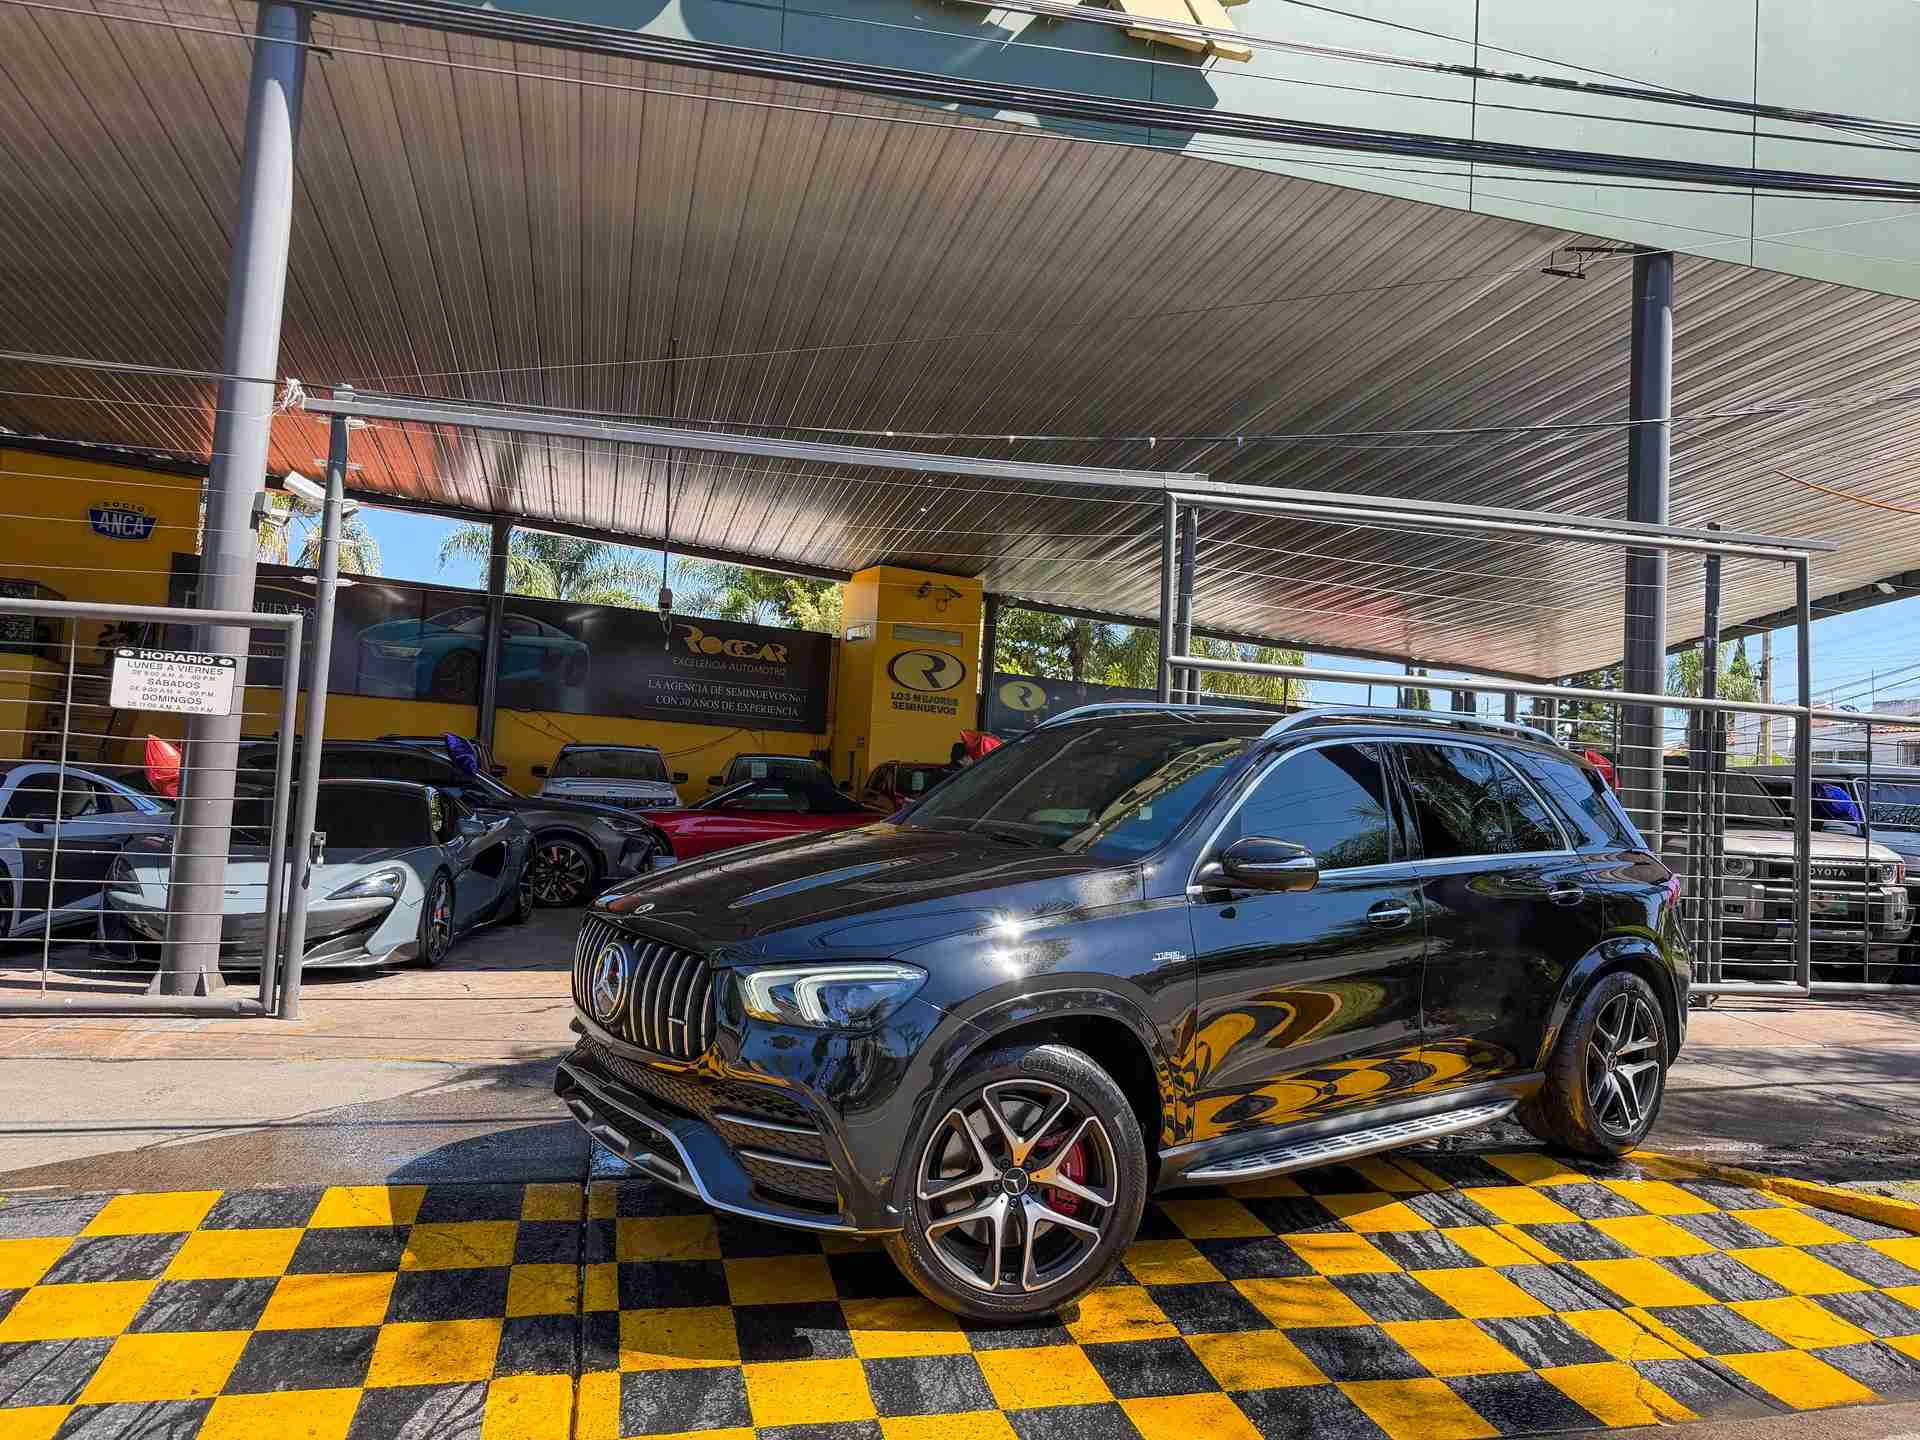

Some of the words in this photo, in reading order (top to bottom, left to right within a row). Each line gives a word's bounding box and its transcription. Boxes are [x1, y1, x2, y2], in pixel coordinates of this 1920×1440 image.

[98, 511, 145, 536] ANCA
[140, 650, 214, 665] HORARIO
[127, 660, 163, 670] LUNES
[167, 664, 175, 672] A
[178, 664, 224, 675] VIERNES
[648, 679, 662, 689] LA
[663, 680, 709, 693] AGENCIA
[710, 684, 723, 695] DE
[725, 687, 789, 702] SEMINUEVOS
[891, 690, 913, 701] LOS
[913, 693, 960, 706] MEJORES
[141, 693, 203, 705] DOMINGOS
[655, 695, 678, 705] CON
[721, 700, 735, 711] DE
[736, 702, 800, 717] EXPERIENCIA
[891, 701, 957, 715] SEMINUEVOS
[1809, 868, 1847, 877] OYOTA
